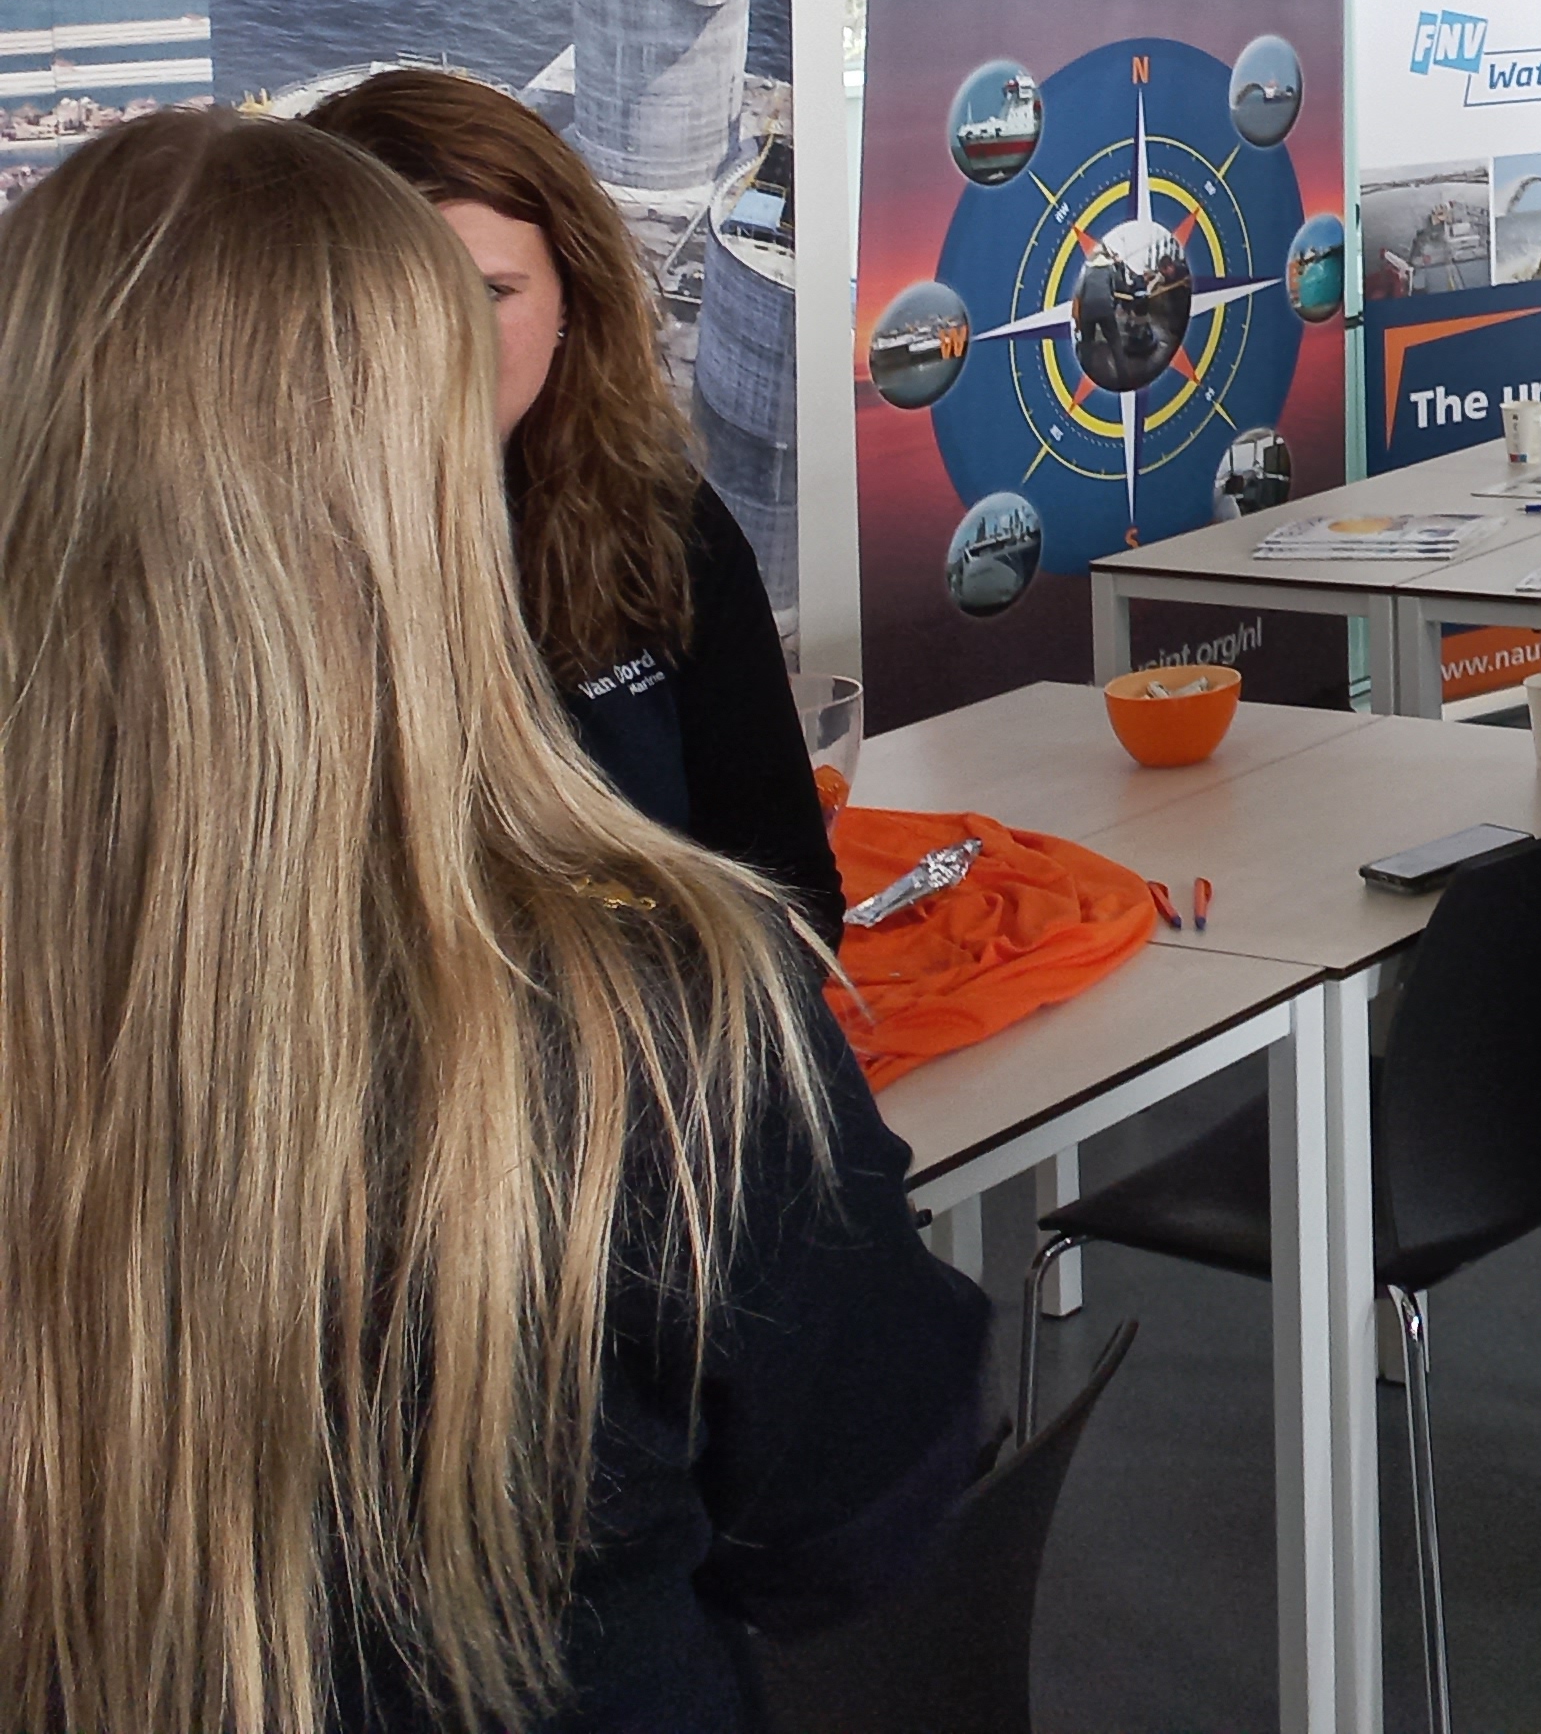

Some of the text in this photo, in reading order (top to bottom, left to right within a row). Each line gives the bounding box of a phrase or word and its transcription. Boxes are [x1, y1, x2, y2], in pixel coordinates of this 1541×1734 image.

[1414, 21, 1487, 63] FNV
[1132, 55, 1150, 85] N
[1409, 385, 1490, 429] The
[577, 648, 656, 700] Van Oord
